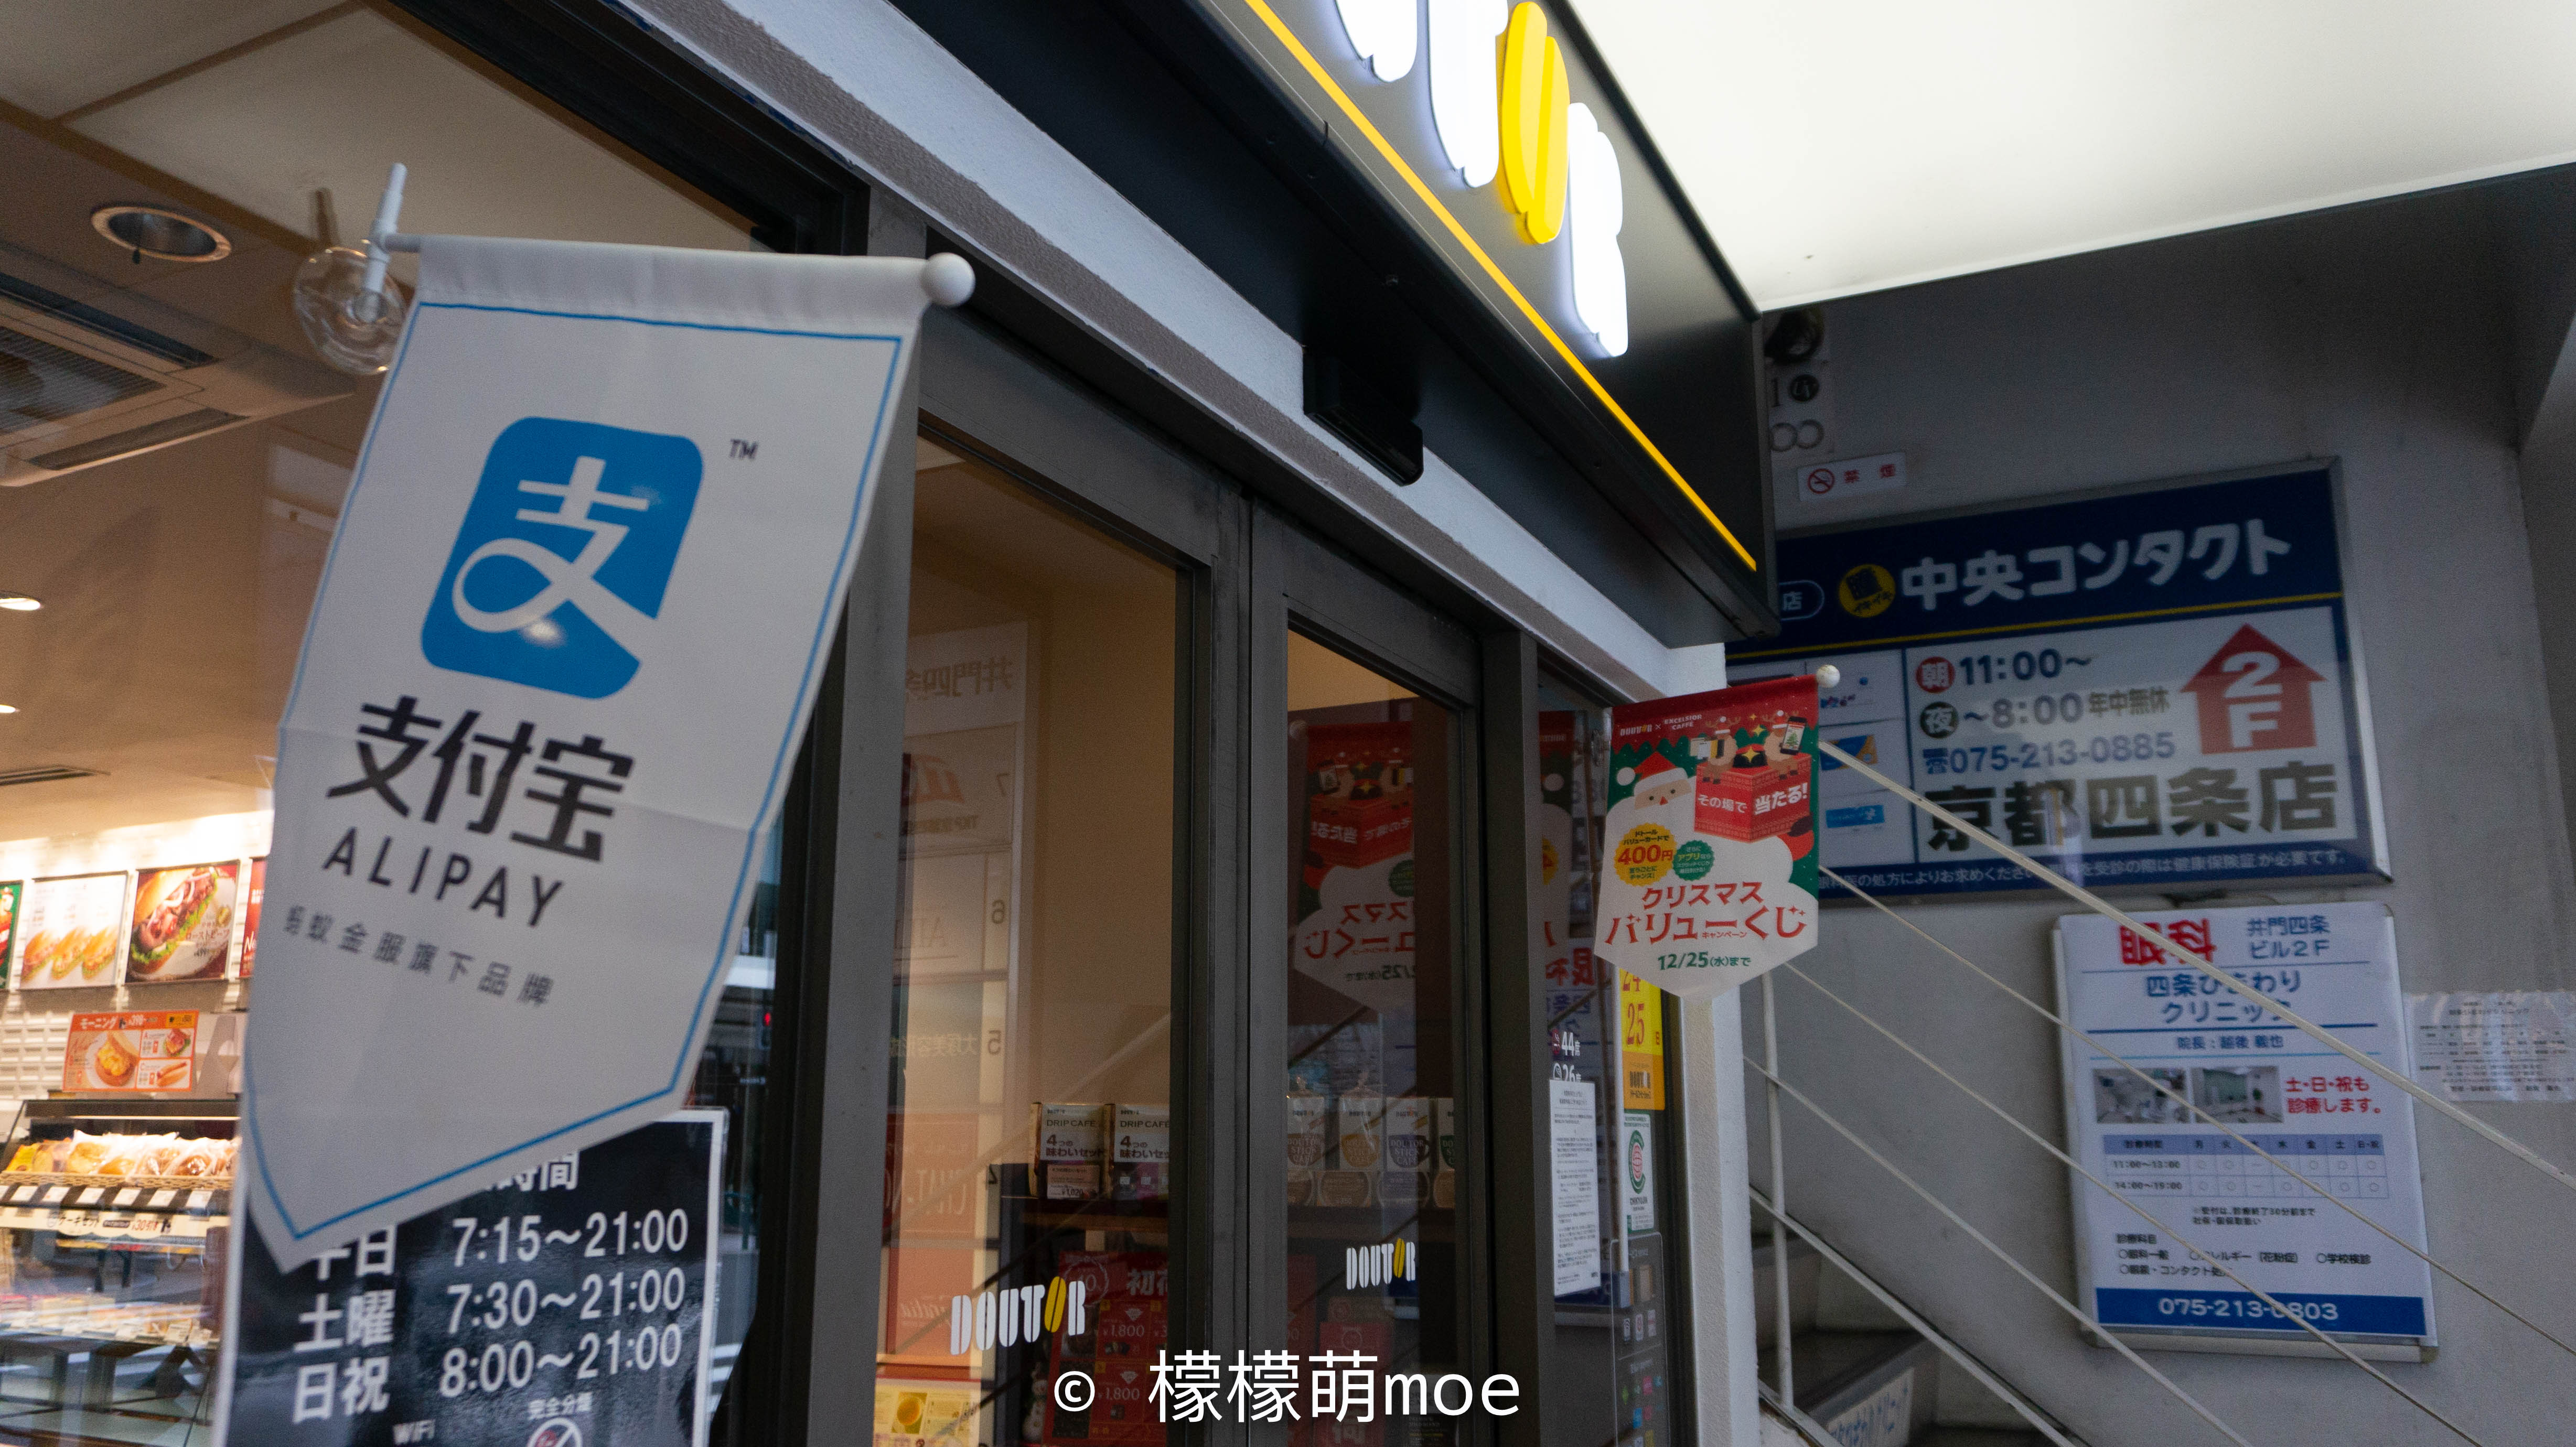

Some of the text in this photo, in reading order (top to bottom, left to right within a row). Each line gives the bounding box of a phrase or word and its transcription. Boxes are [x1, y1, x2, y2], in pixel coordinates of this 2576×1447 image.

[1902, 517, 2291, 611] 中央コンタクト
[1922, 661, 1950, 689] 朝
[1924, 707, 1953, 733] 夜
[2089, 686, 2170, 716] 年中無休
[1950, 731, 2176, 773] 075-213-0885
[327, 695, 635, 863] 支付宝
[1698, 794, 1748, 814] その場で
[1926, 764, 2338, 852] 京都四条店
[1617, 845, 1673, 866] 400円
[1623, 835, 1669, 846] バリューカードで
[322, 826, 563, 928] ALIPAY
[1641, 881, 1765, 910] クリスマス
[1604, 905, 1808, 945] バリューくじ
[1702, 931, 1747, 939] キャンペーン
[2119, 914, 2332, 966] 眼科 井門四条
[1657, 951, 1752, 971] 12/25(水)まで
[80, 1014, 118, 1030] モーニング
[1627, 1002, 1645, 1045] 25
[2287, 1098, 2381, 1115] 診療します。
[1046, 1134, 1074, 1147] 4つの
[1046, 1147, 1104, 1157] 味わいセット
[1120, 1135, 1147, 1148] 4つの
[1346, 1238, 1416, 1290] DOUTOR
[294, 1289, 396, 1354] 土曜
[950, 1276, 1086, 1356] DOUTOR
[293, 1357, 390, 1424] 日祝
